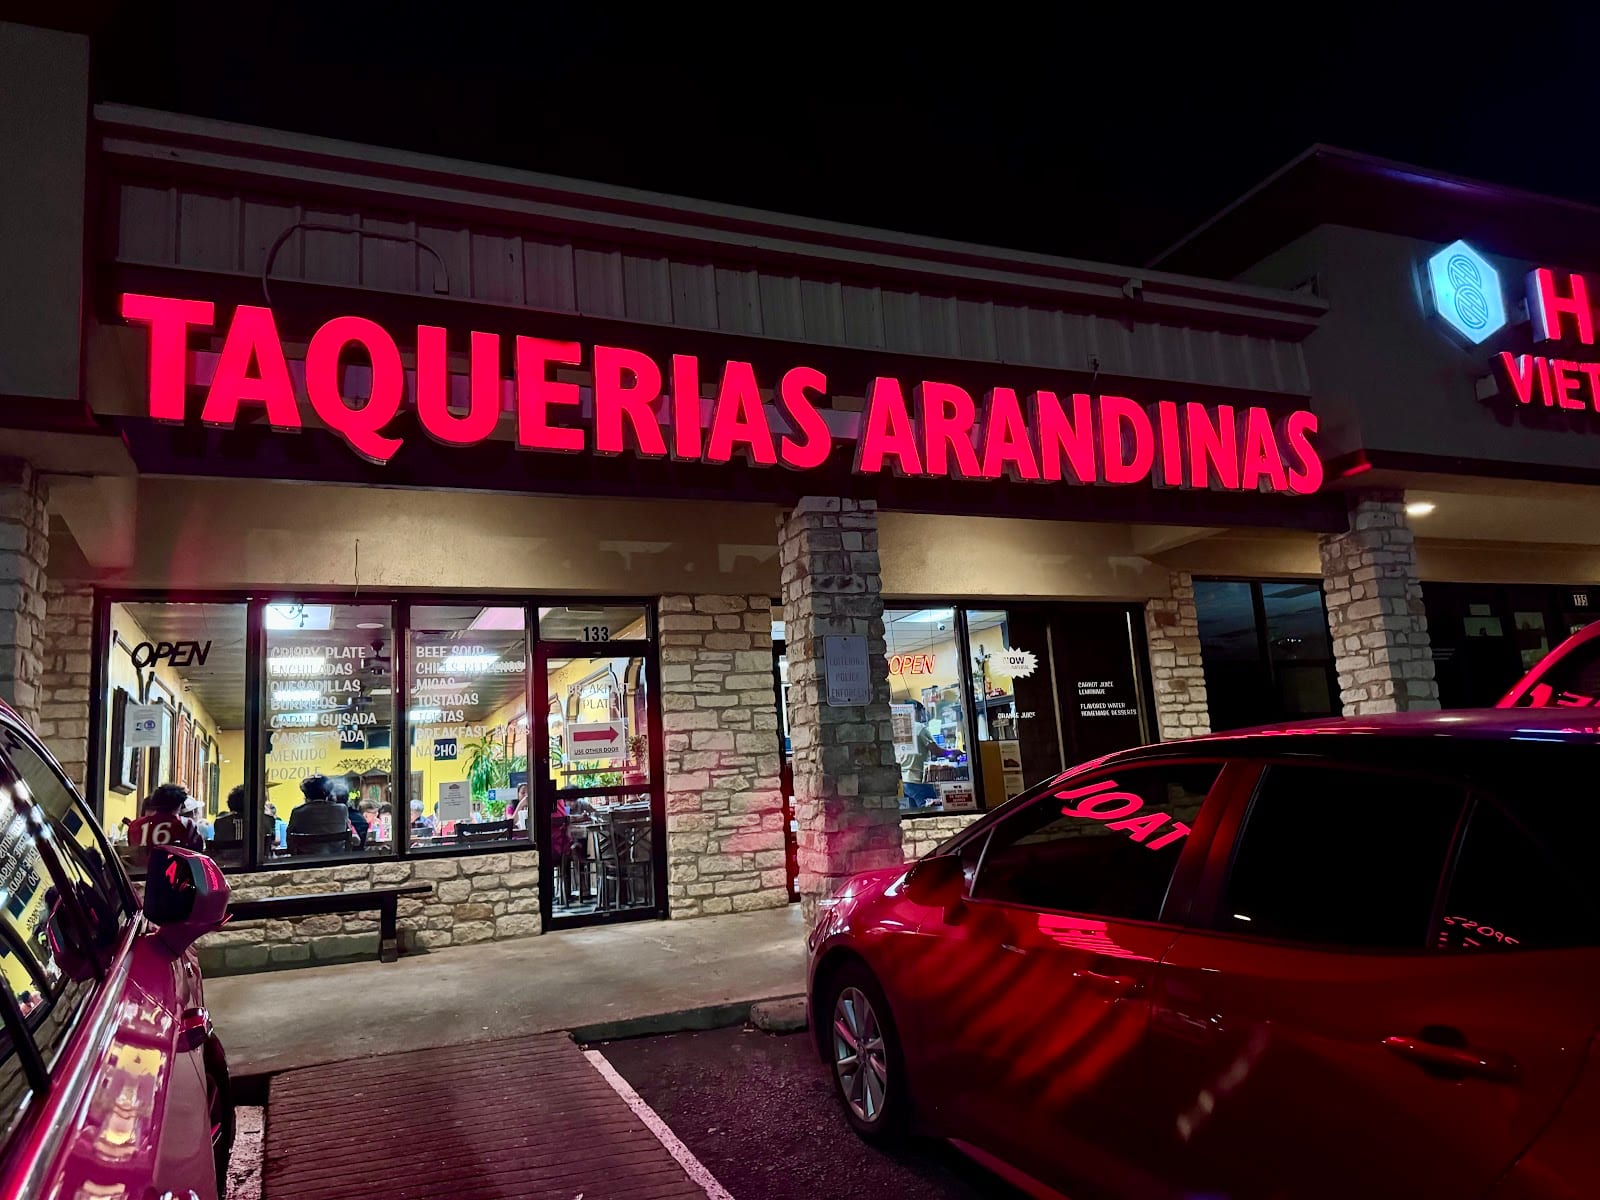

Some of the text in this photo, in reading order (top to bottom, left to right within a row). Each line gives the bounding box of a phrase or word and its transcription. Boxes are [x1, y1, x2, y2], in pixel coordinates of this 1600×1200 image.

[121, 292, 1324, 495] TAQUERIAS ARANDINAS
[583, 626, 609, 641] 133
[131, 640, 212, 668] OPEN
[271, 646, 366, 659] CRISPY PLATE
[451, 645, 484, 658] SOUP
[271, 662, 353, 676] ENCHILADAS
[889, 654, 936, 674] OPEN
[270, 679, 361, 693] QUESADILLAS
[270, 696, 338, 711] BURRITOS
[416, 693, 479, 706] TOSTADAS
[320, 712, 378, 726] GUISADA
[417, 709, 465, 723] TORTAS
[416, 725, 488, 740] BREAKFAST
[271, 748, 327, 762] MENUDO
[140, 822, 172, 847] 16
